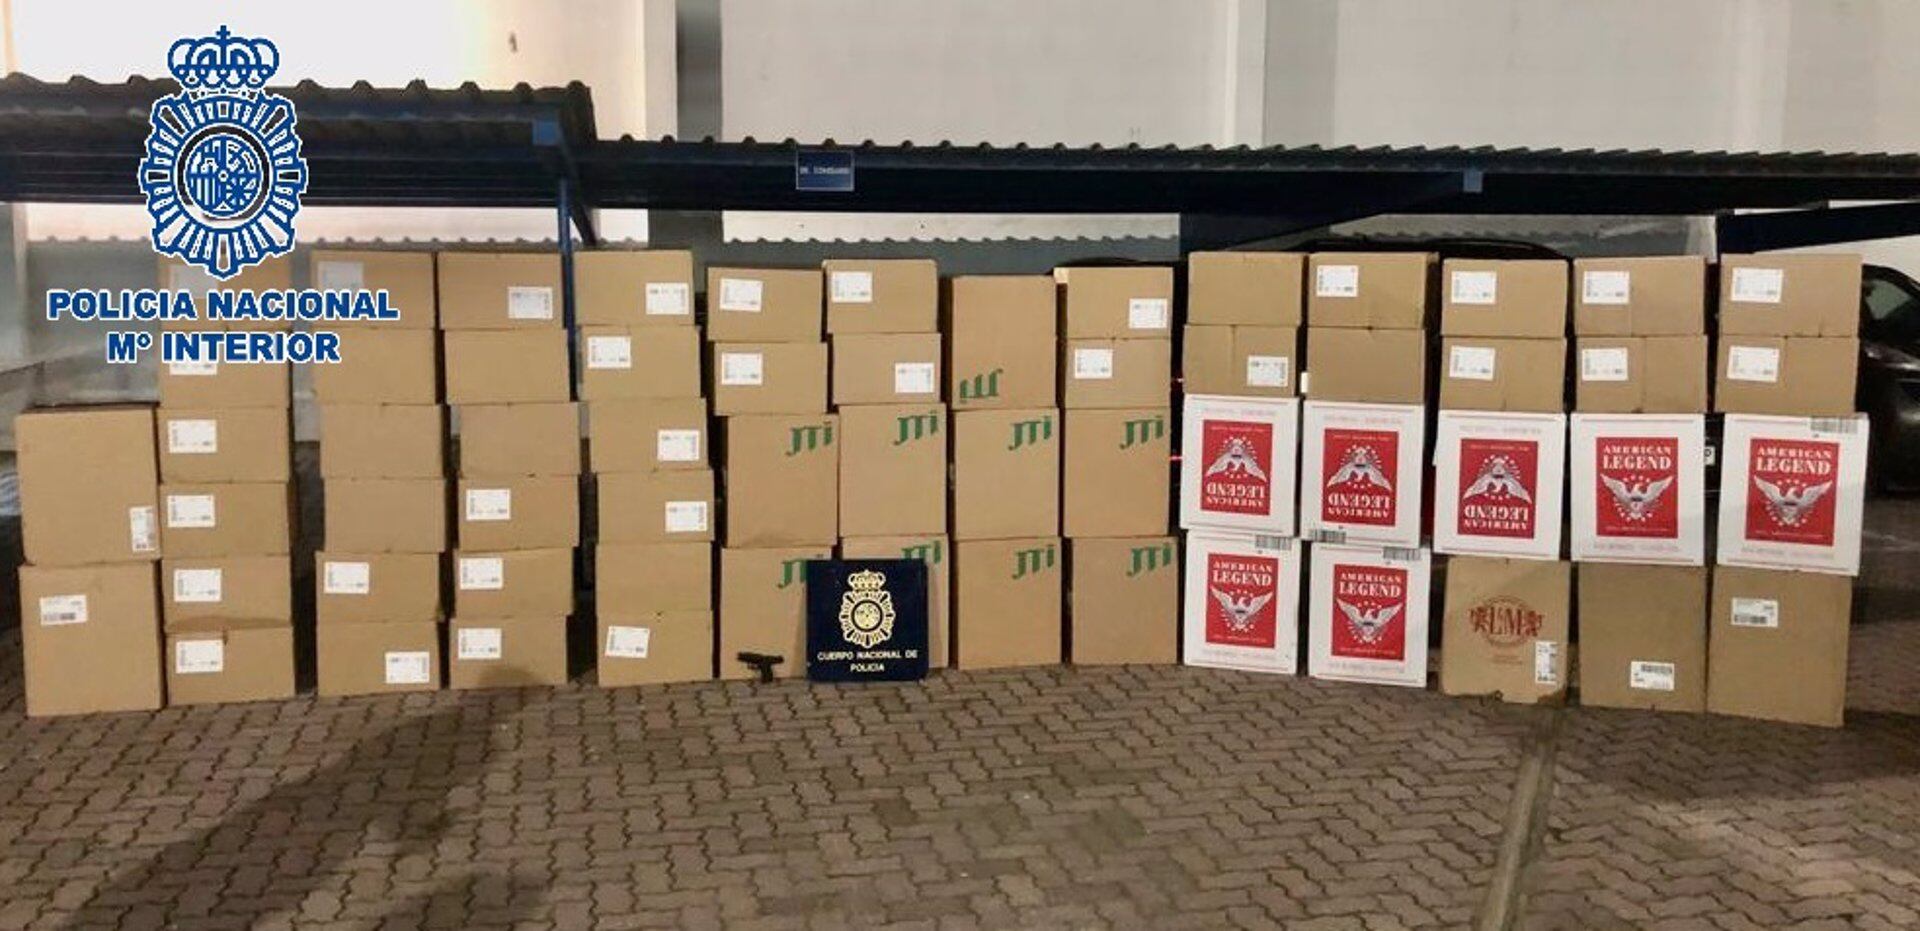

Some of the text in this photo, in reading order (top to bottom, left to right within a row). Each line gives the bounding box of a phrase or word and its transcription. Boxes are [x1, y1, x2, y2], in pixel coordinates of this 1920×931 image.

[1603, 445, 1672, 455] AMERICAN
[1757, 447, 1832, 459] AMERICAN
[1603, 455, 1672, 470] LEGEND
[1756, 457, 1832, 475] LEGEND
[1327, 492, 1391, 510] LEGEND
[1463, 504, 1529, 521] LEGEND
[1212, 561, 1273, 573] AMERICAN
[1212, 570, 1272, 587] LEGEND
[1340, 573, 1401, 584] AMERICAN
[1339, 581, 1401, 598] LEGEND
[817, 649, 919, 661] CUERPO NACIONAL DE
